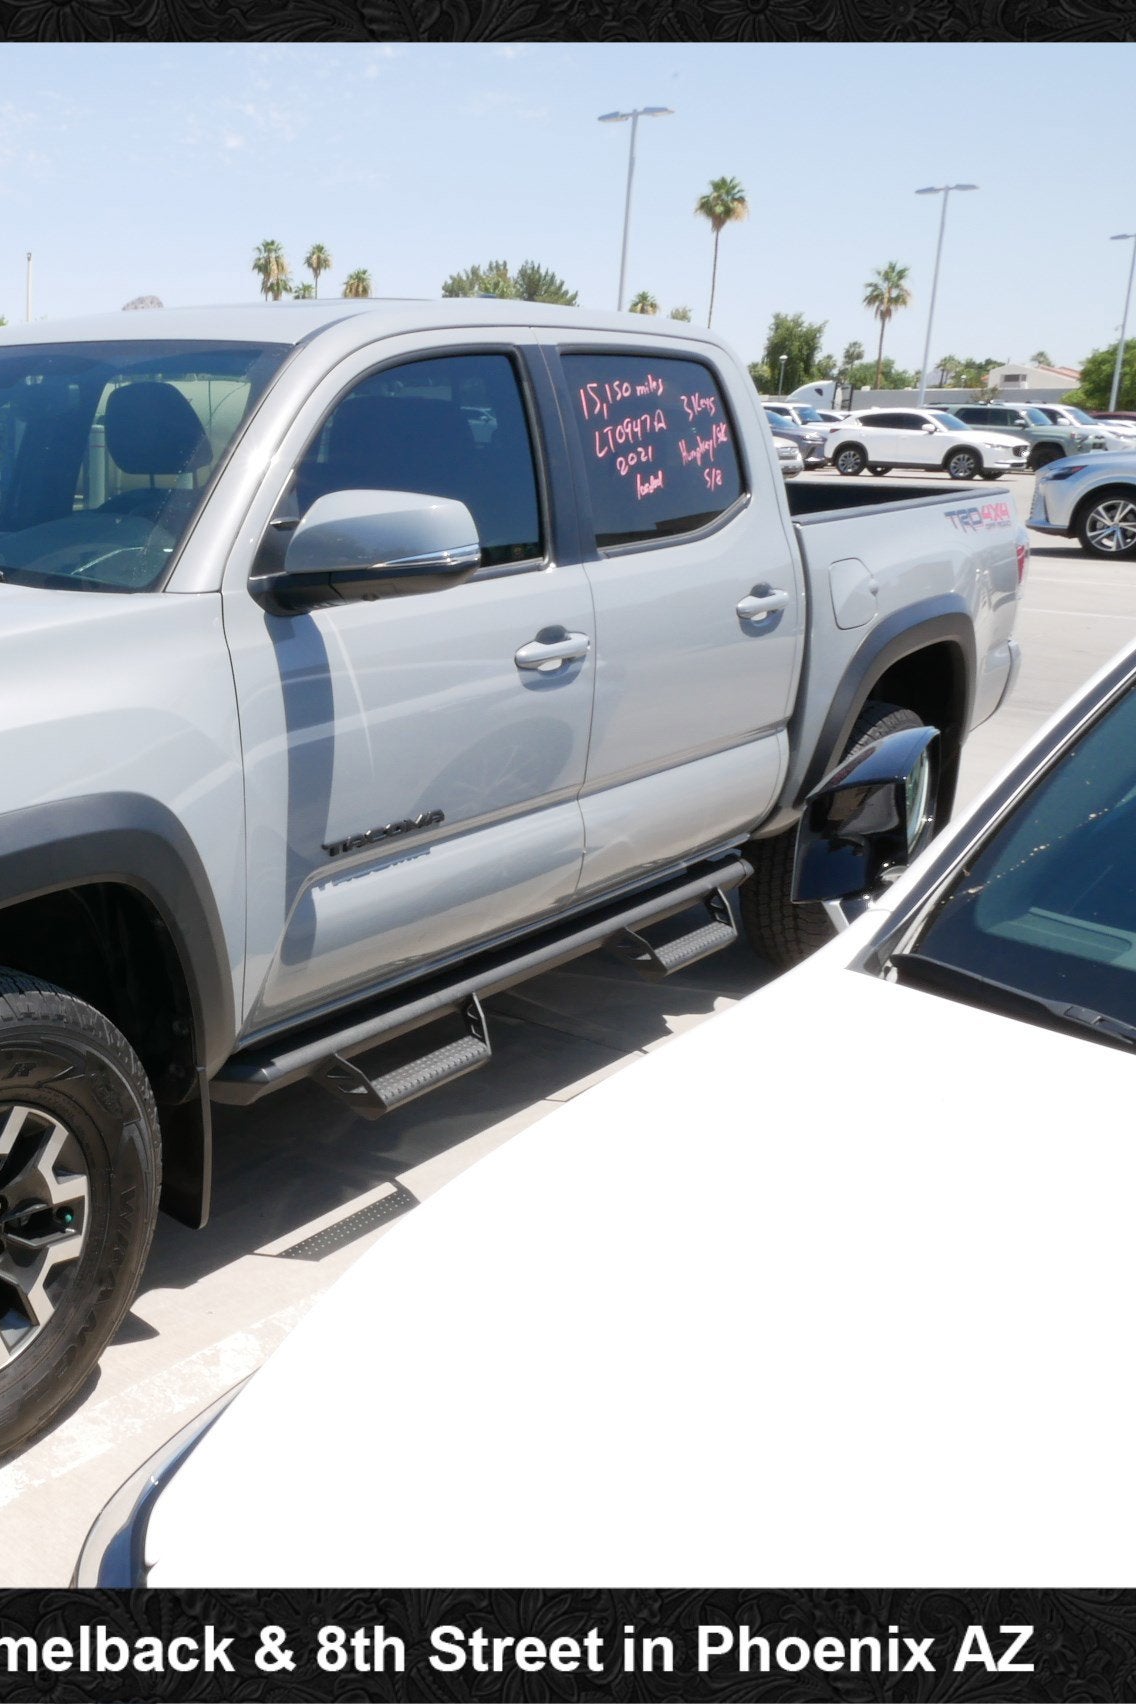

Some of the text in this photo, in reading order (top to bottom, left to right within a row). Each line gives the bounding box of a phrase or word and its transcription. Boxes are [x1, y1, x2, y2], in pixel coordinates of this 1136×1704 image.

[580, 374, 664, 420] 15,150 miles
[680, 395, 693, 422] 3
[616, 446, 653, 476] 2021
[944, 507, 984, 534] TRD
[321, 809, 445, 857] TACOMA
